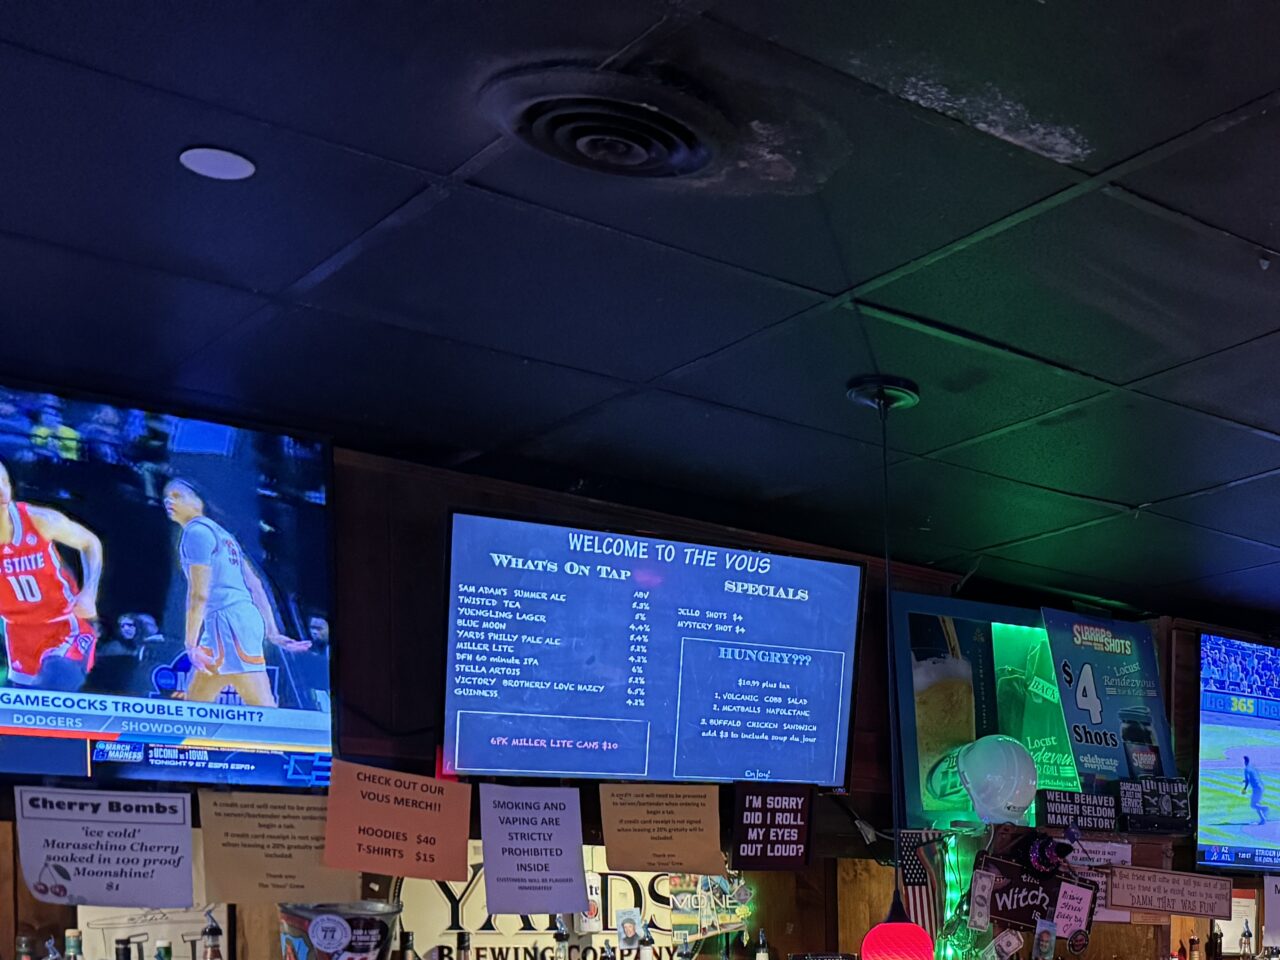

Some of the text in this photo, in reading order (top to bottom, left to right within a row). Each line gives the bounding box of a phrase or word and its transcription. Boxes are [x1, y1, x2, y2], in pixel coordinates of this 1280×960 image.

[569, 532, 771, 574] WELCOME TO THE VOUS
[3, 552, 45, 574] STATE
[490, 552, 631, 581] WHAT'S ON TAP
[7, 574, 42, 603] 10
[458, 583, 476, 593] SAM
[514, 589, 548, 600] SUMMER
[550, 593, 567, 602] ALE
[724, 580, 809, 601] SPECIALS
[458, 595, 521, 608] TWISTED TEA
[458, 607, 547, 622] YUENGLING LAGER
[706, 610, 727, 620] SHOTS
[457, 618, 506, 630] BLUE MOON
[677, 620, 733, 632] MYSTERY SHOT
[457, 630, 561, 646] YARDS PHILLY PALE ALE
[456, 642, 514, 653] MILLER LITE
[523, 657, 539, 666] IPA
[718, 646, 812, 666] HUNGRY???
[455, 664, 521, 676] STELLA ARTOIS
[455, 675, 605, 693] VICTORY BROTHERLY LOVE HAZEY
[1031, 678, 1059, 702] BACK
[454, 688, 499, 698] GUINNESS
[0, 693, 264, 723] GAMECOCKS TROUBLE TONIGHT?
[13, 713, 207, 736] DODGERS SHOWDOWN
[709, 719, 817, 732] BUFFALO CHICKEN SANDWICH
[490, 737, 619, 751] 6PK MILLER LITE CANS $10
[1072, 724, 1118, 748] Shots
[356, 771, 445, 796] CHECK OUT OUR
[28, 796, 179, 815] Cherry Bombs
[360, 790, 442, 813] VOUS MERCH!!
[492, 799, 567, 812] SMOKING AND
[745, 795, 805, 810] I'M SORRY
[1046, 790, 1115, 807] WELL BEHAVED
[743, 811, 804, 825] DID I ROLL
[1046, 802, 1116, 818] WOMEN SELDOM
[498, 815, 561, 827] VAPING ARE
[1047, 813, 1116, 830] MAKE HISTORY
[358, 826, 436, 846] HOODIES $40
[508, 831, 553, 842] STRICTLY
[748, 828, 798, 841] MY EYES
[43, 839, 180, 855] Maraschino Cherry
[357, 843, 436, 864] T-SHIRTS $15
[501, 847, 564, 858] PROHIBITED
[740, 844, 805, 857] OUT LOUD?
[46, 853, 184, 868] soaked in 100 proof
[516, 863, 551, 873] INSIDE
[73, 867, 155, 879] Moonshine!
[436, 863, 673, 933] YDS
[995, 886, 1050, 911] Witch
